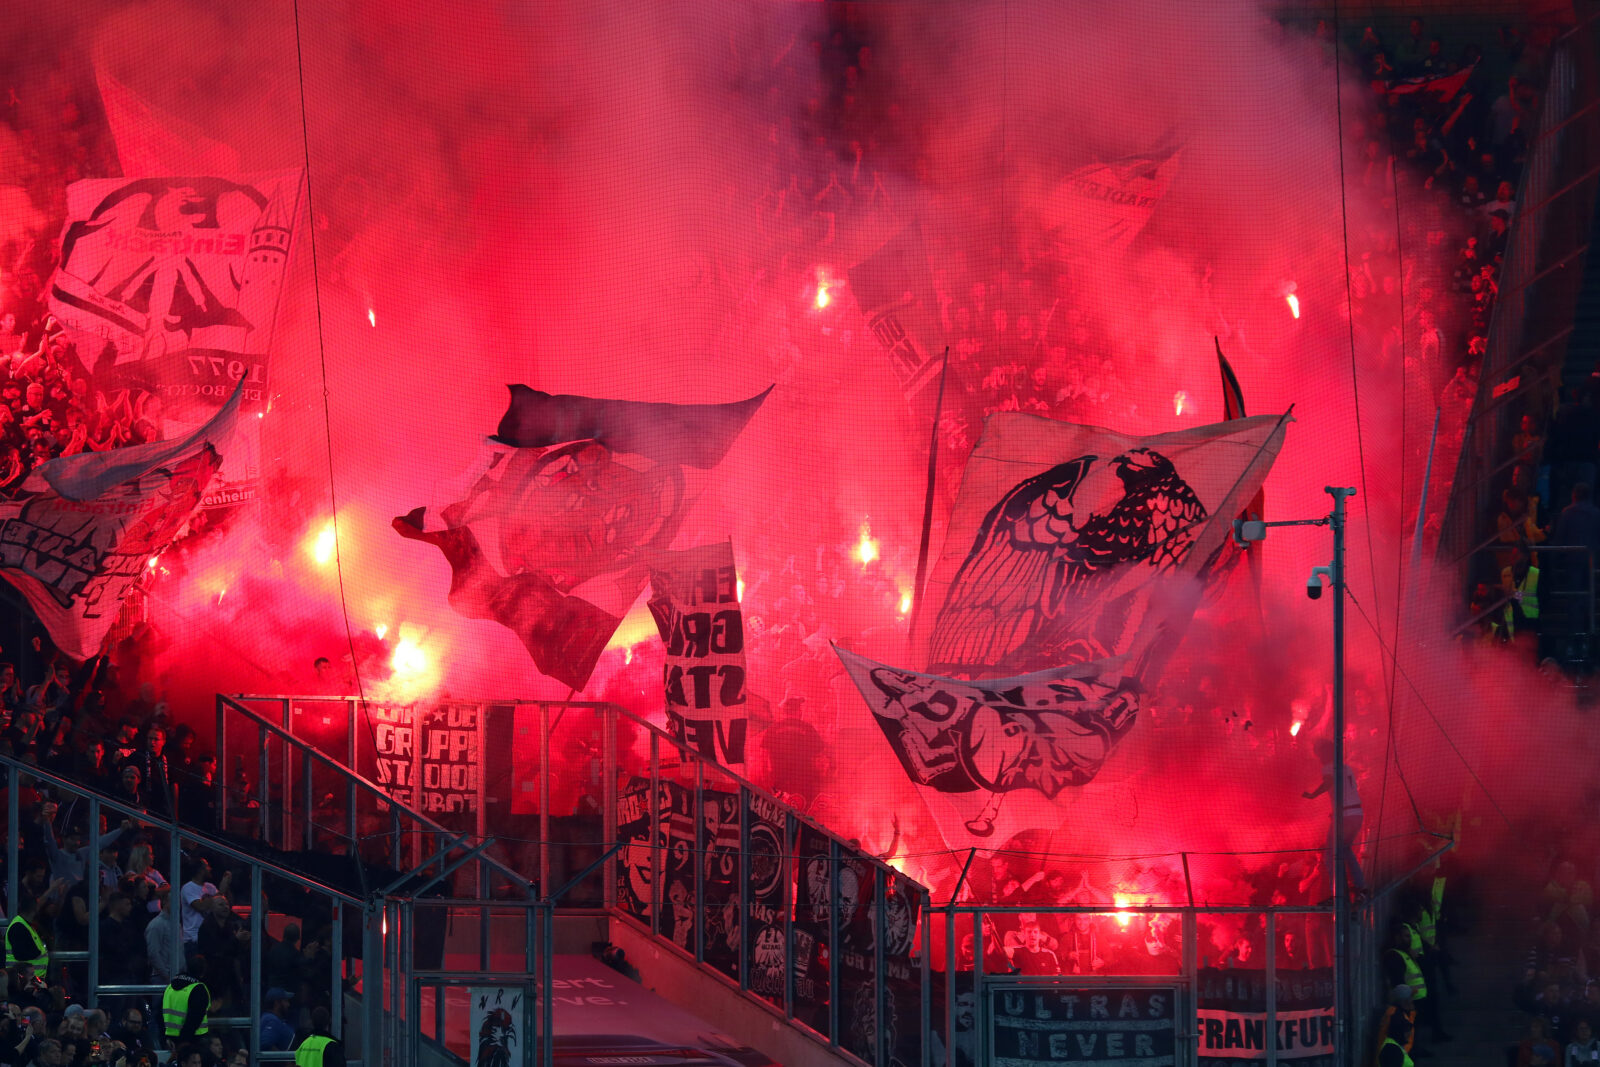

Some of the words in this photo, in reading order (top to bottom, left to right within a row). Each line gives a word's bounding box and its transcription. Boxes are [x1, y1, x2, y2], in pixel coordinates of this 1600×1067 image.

[550, 978, 615, 989] ert
[1003, 991, 1167, 1019] ULTRAS
[1017, 1031, 1156, 1058] NEVER
